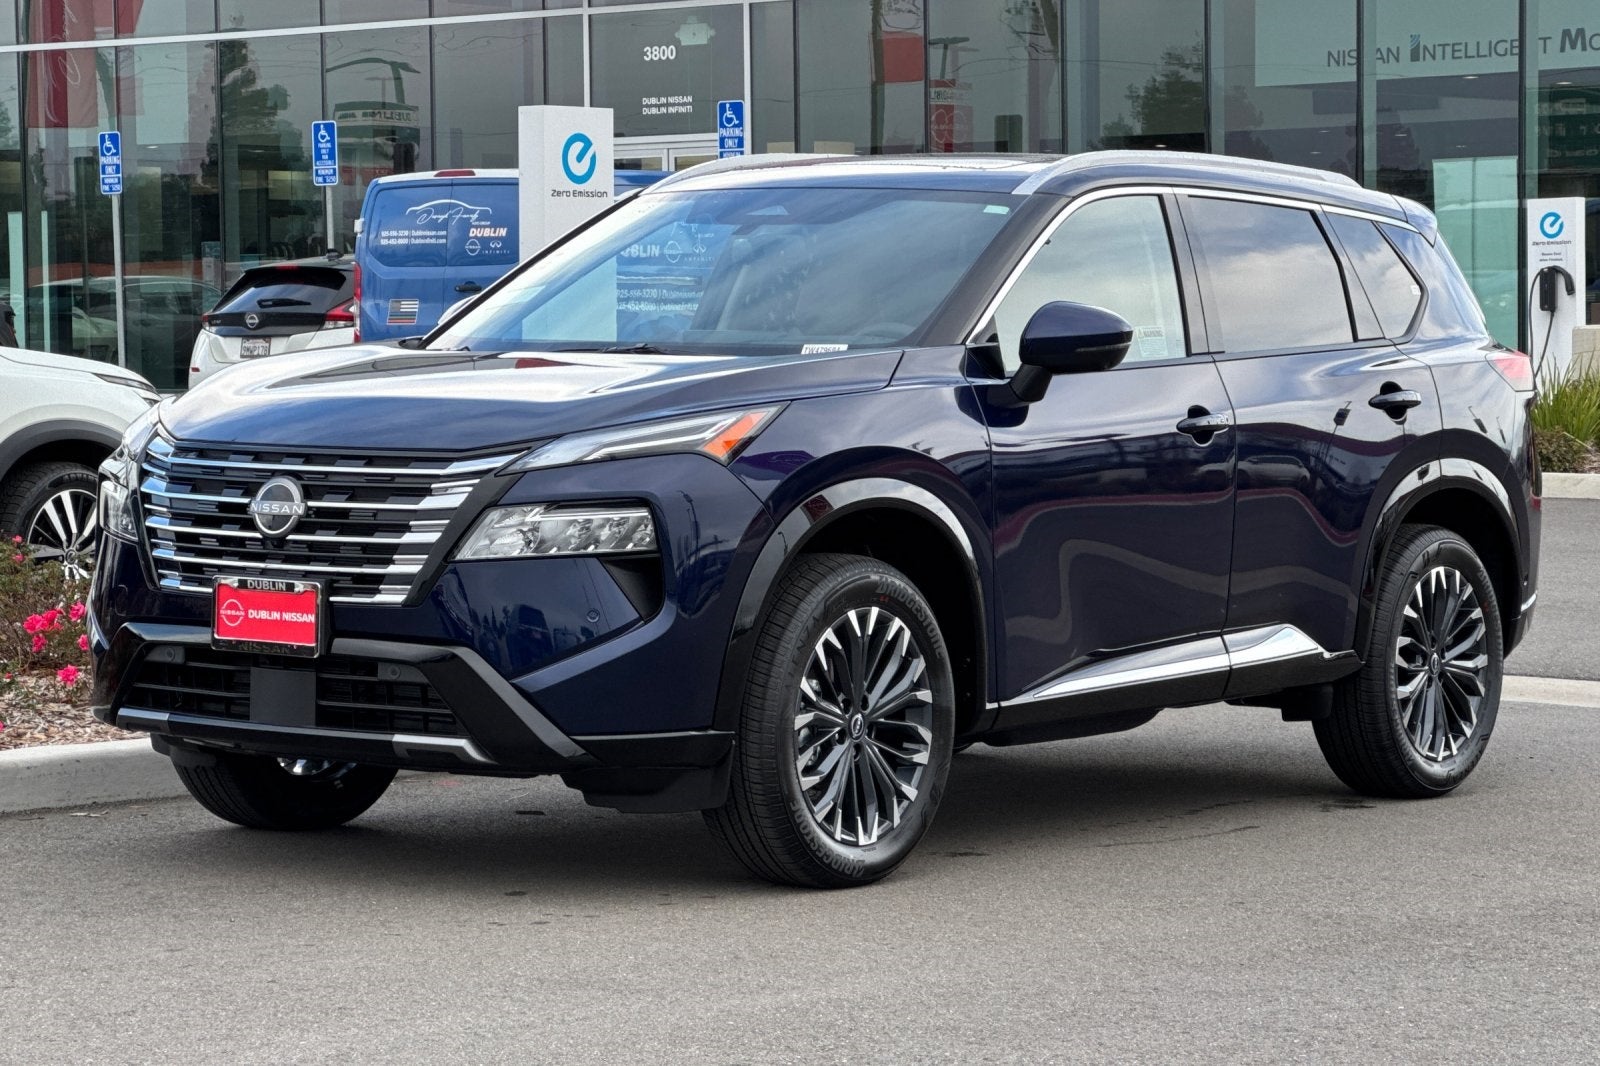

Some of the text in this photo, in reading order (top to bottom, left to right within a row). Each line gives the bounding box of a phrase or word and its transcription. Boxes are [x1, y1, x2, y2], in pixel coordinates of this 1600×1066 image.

[643, 45, 676, 61] 3800
[1327, 46, 1400, 67] NISAN
[1410, 34, 1552, 62] INTELLIGET
[642, 95, 693, 105] DUBLIN NISSAN
[642, 105, 693, 115] DUBLIN INFINITI
[720, 127, 743, 138] PARKING
[724, 138, 739, 148] ONLY
[101, 156, 121, 164] PARKING
[104, 165, 116, 175] ONLY
[551, 189, 608, 198] Zero Emission
[469, 228, 508, 237] DUBLIN
[251, 502, 303, 514] NISSAN
[247, 580, 287, 591] DUBLIN
[248, 608, 315, 623] DUBLIN NISSAN
[876, 576, 945, 660] BRIDGESTONE
[789, 801, 865, 878] BRIDGESTONE
